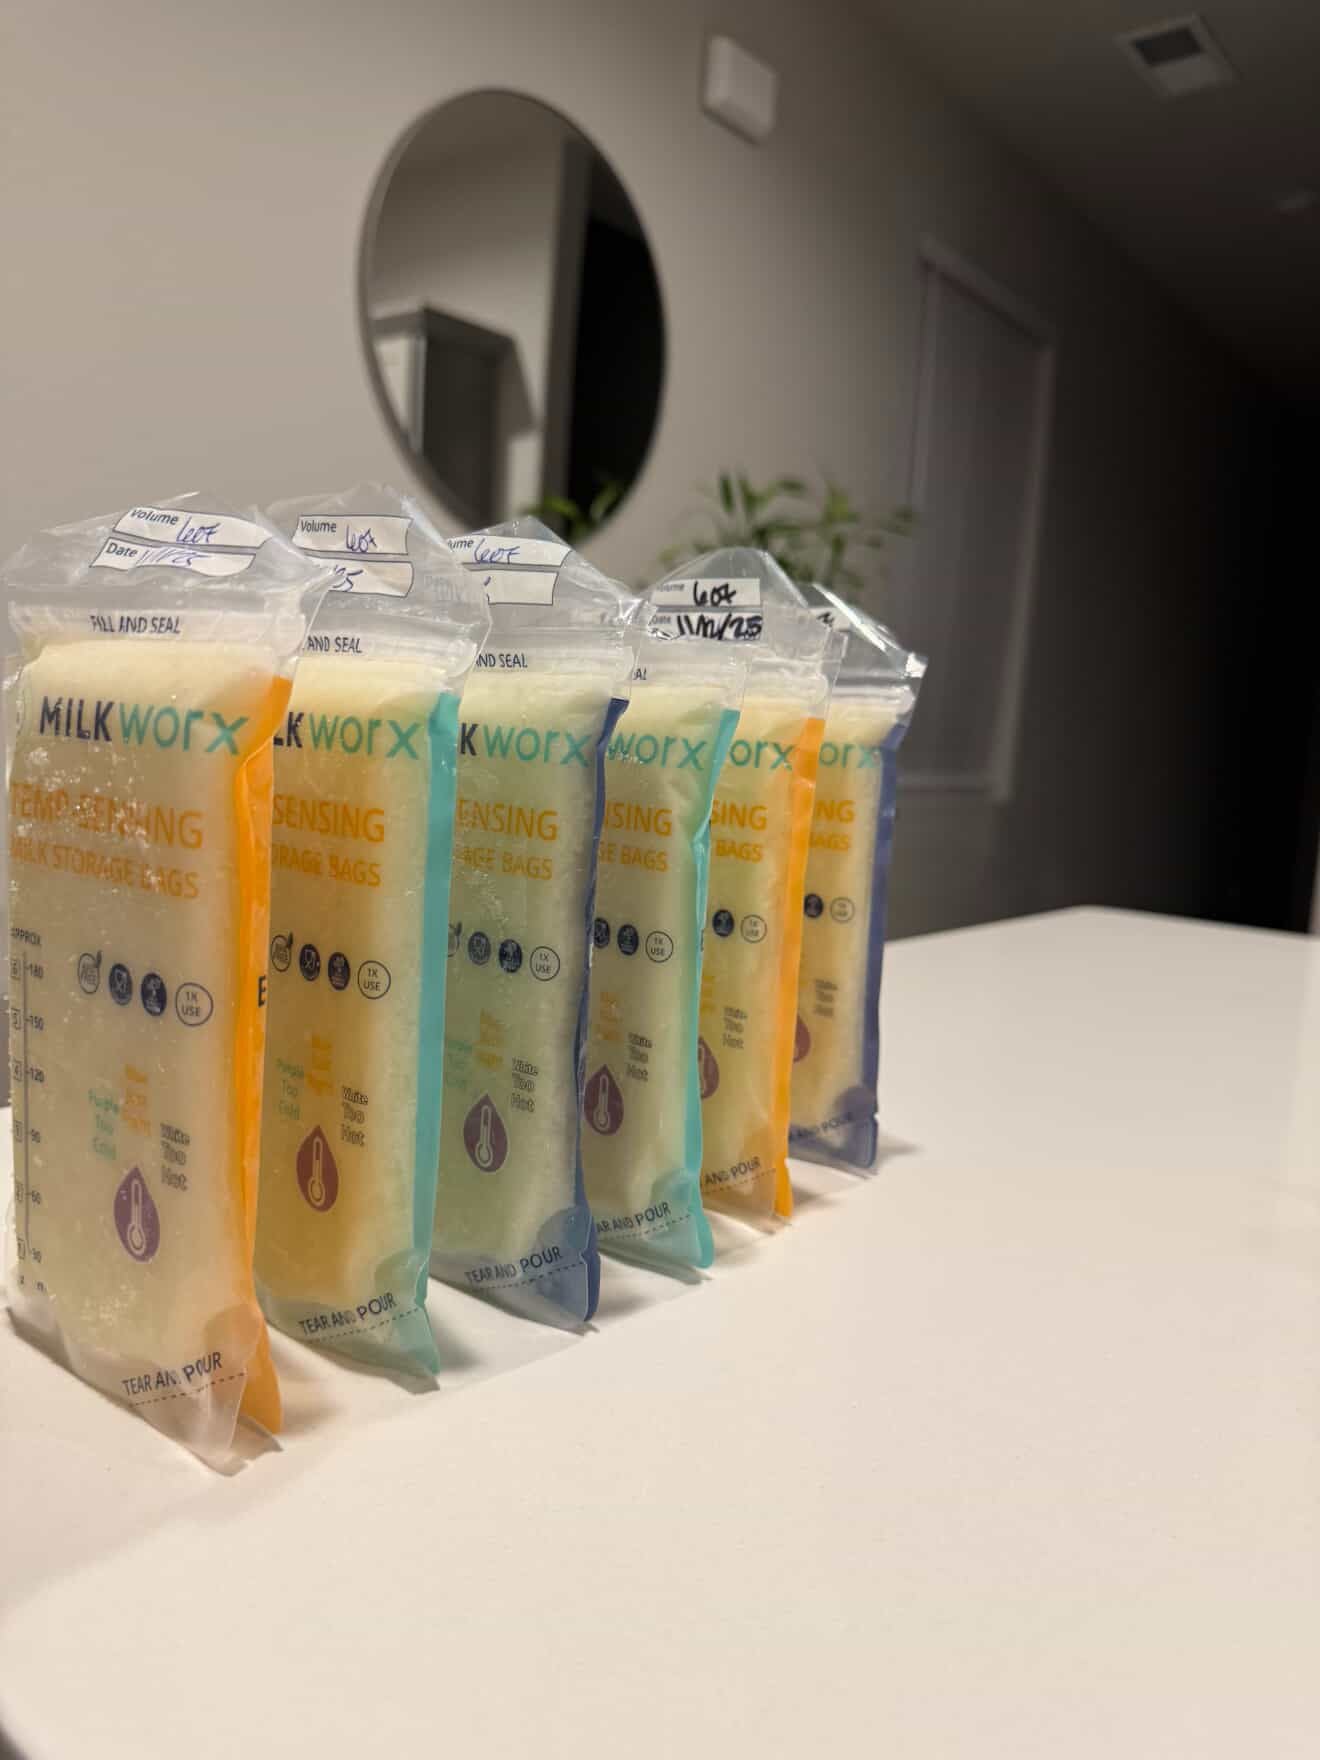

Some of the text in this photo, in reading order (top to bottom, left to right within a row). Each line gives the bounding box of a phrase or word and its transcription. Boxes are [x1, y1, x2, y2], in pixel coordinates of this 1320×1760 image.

[130, 508, 180, 526] Volume
[300, 520, 337, 533] Volume
[105, 541, 138, 558] Date
[119, 615, 147, 632] AND
[150, 615, 181, 633] SEAL
[307, 636, 362, 653] AND SEAL
[500, 653, 528, 669] SEAL
[458, 795, 559, 842] ENSING
[620, 845, 668, 872] BAGS
[715, 838, 764, 863] BAGS
[501, 852, 553, 881] BAGS
[650, 946, 666, 956] USE
[535, 963, 551, 975] USE
[363, 980, 381, 992] USE
[181, 1004, 201, 1018] USE
[634, 1201, 672, 1226] POUR
[494, 1262, 517, 1279] AND
[519, 1246, 563, 1272] POUR
[356, 1291, 397, 1320] POUR
[121, 1351, 223, 1396] TEAR AN POUR
